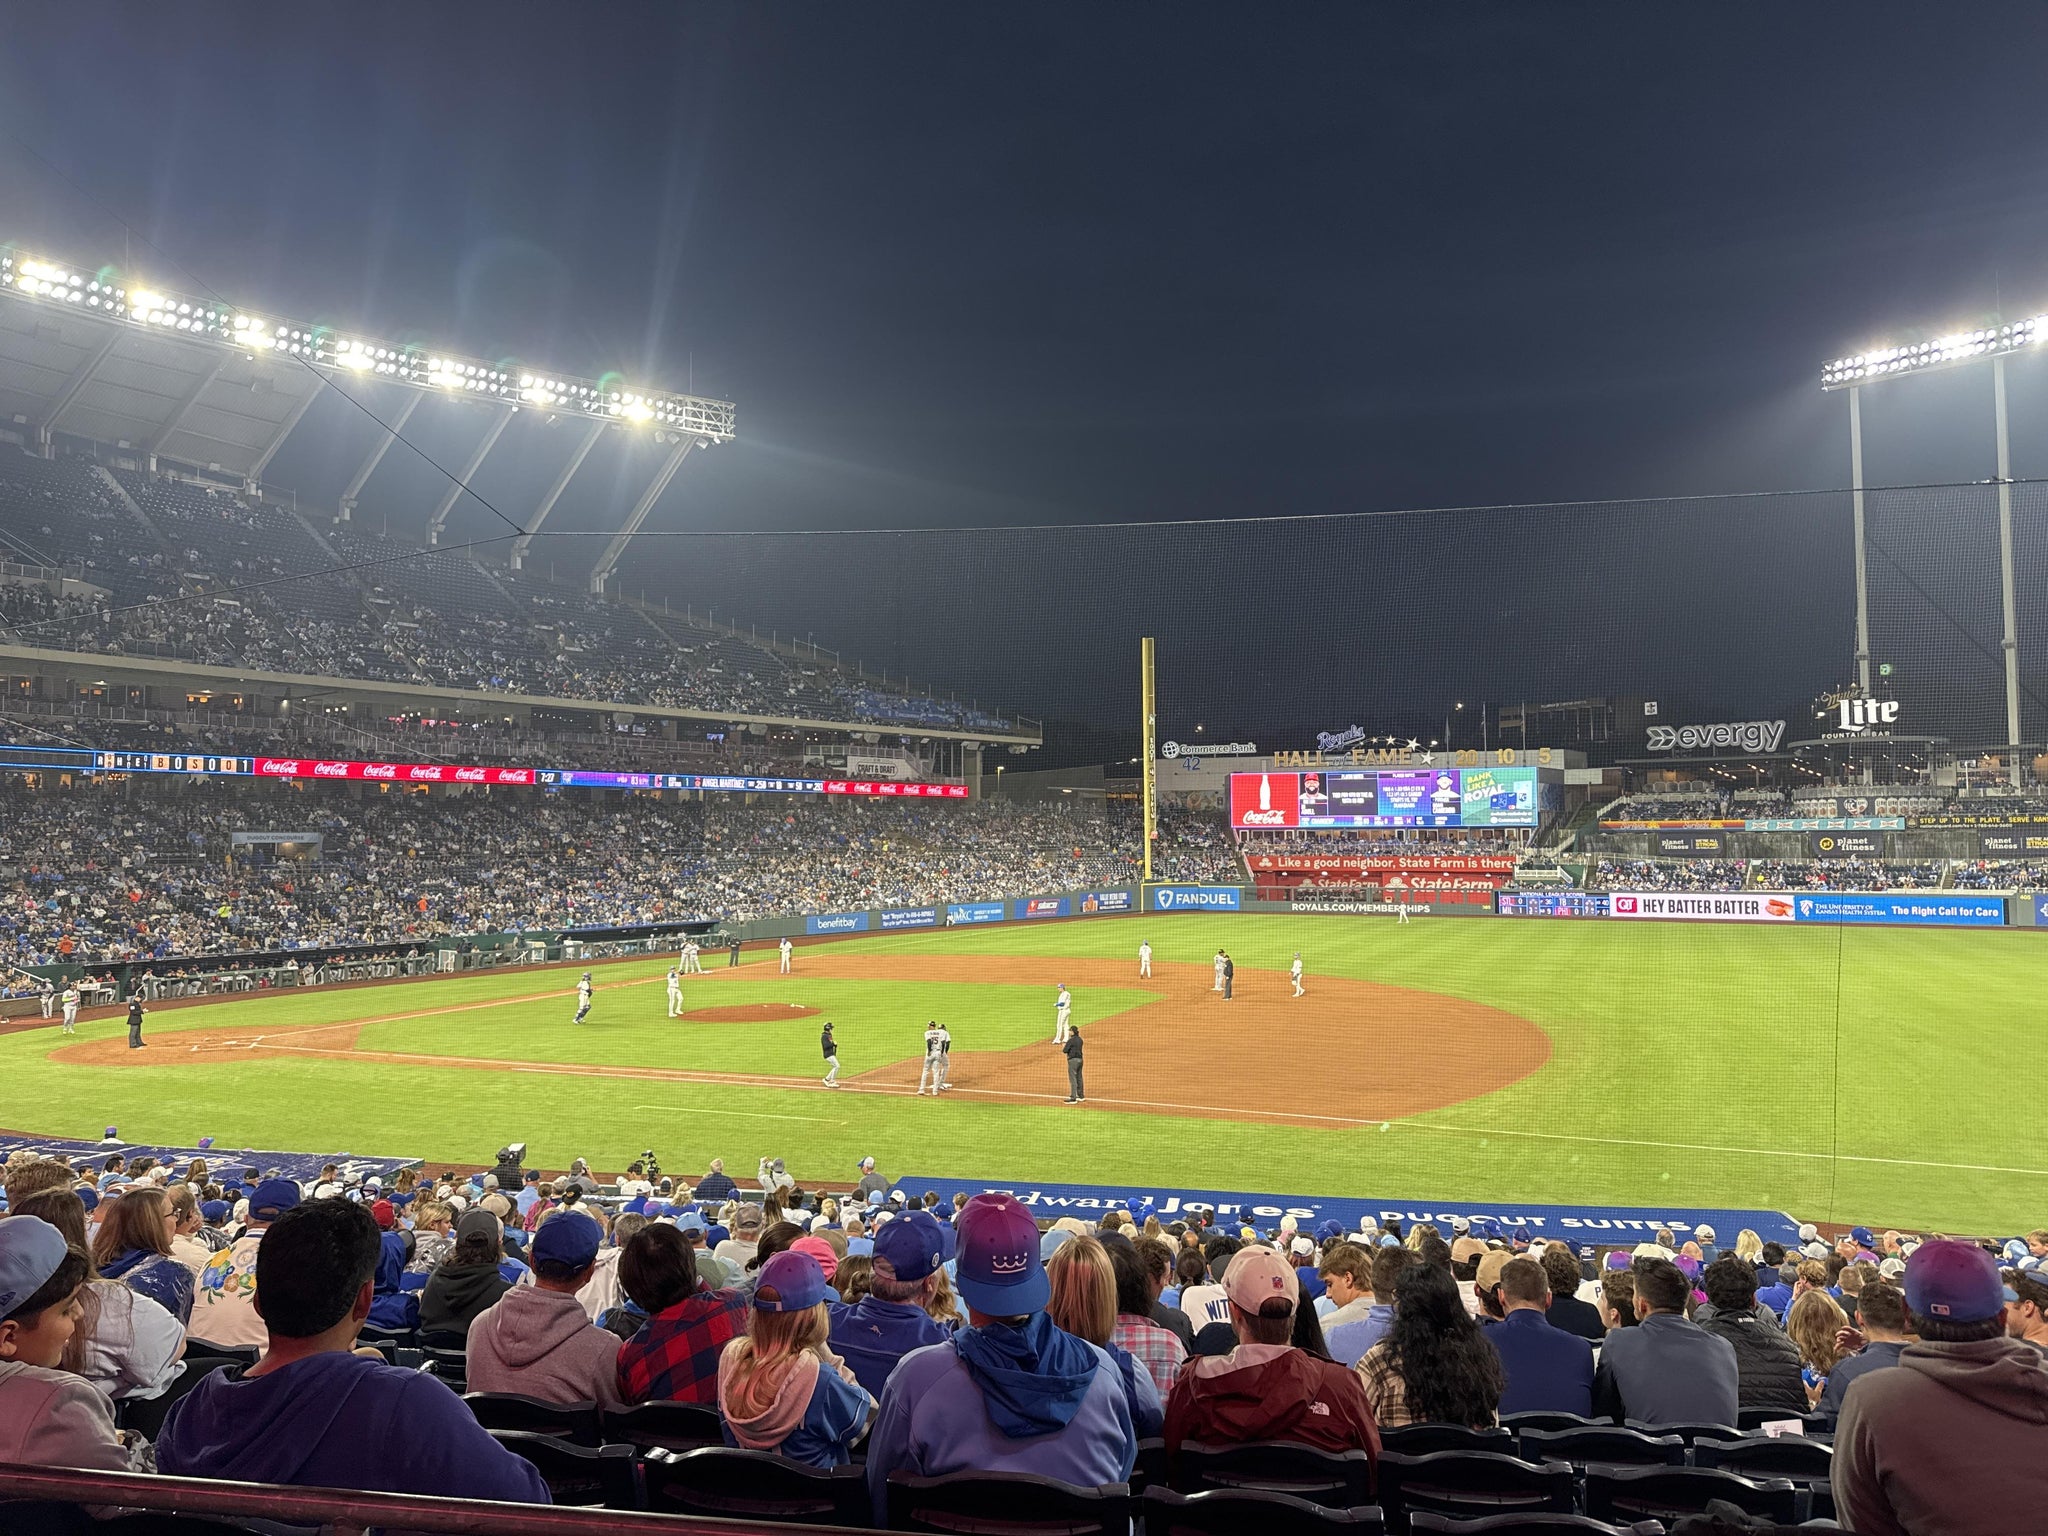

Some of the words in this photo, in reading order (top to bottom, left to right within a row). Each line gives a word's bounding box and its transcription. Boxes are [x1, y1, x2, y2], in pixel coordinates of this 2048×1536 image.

[1821, 687, 1864, 708] Miller
[1838, 699, 1899, 731] Lite
[1317, 724, 1366, 751] Royals
[1679, 720, 1785, 752] evergy
[1822, 732, 1866, 740] FOUNTAIN
[1180, 744, 1229, 754] Commerce
[1230, 742, 1257, 753] Bank
[1274, 750, 1330, 768] HALL
[1332, 752, 1351, 767] of
[1352, 748, 1413, 766] FAME
[1456, 749, 1478, 766] 20
[1495, 748, 1516, 764] 10
[1539, 748, 1552, 764] 5
[158, 758, 164, 768] B
[192, 760, 198, 768] S
[242, 760, 248, 772] 1
[858, 764, 874, 774] CRAFT
[880, 766, 896, 774] DRAFT
[1183, 758, 1200, 771] 42
[1467, 770, 1492, 784] BANK
[1468, 780, 1487, 792] LIKE
[1488, 778, 1496, 786] A
[1464, 784, 1506, 804] ROYAL
[1242, 810, 1286, 825] Coca-Cola
[1837, 838, 1868, 846] planet
[1841, 843, 1874, 851] fitness
[1985, 837, 2012, 845] planet
[1278, 858, 1301, 868] Like
[1314, 858, 1340, 870] good
[1344, 858, 1396, 870] neighbor,
[1400, 858, 1430, 868] State
[1434, 858, 1464, 868] Farm
[1468, 858, 1478, 868] is
[1176, 893, 1235, 905] FANDUEL
[1618, 900, 1636, 911] QT
[1558, 908, 1568, 916] PHI
[1643, 899, 1664, 913] HEY
[1668, 900, 1712, 914] BATTER
[1714, 900, 1760, 915] BATTER
[1892, 906, 1910, 916] The
[1912, 906, 1936, 918] Right
[1938, 906, 1958, 916] Call
[1959, 907, 1972, 916] for
[1972, 908, 1998, 917] Care
[818, 918, 858, 928] benefitbay
[1156, 1198, 1316, 1220] Jones
[1561, 1217, 1692, 1232] SUITES
